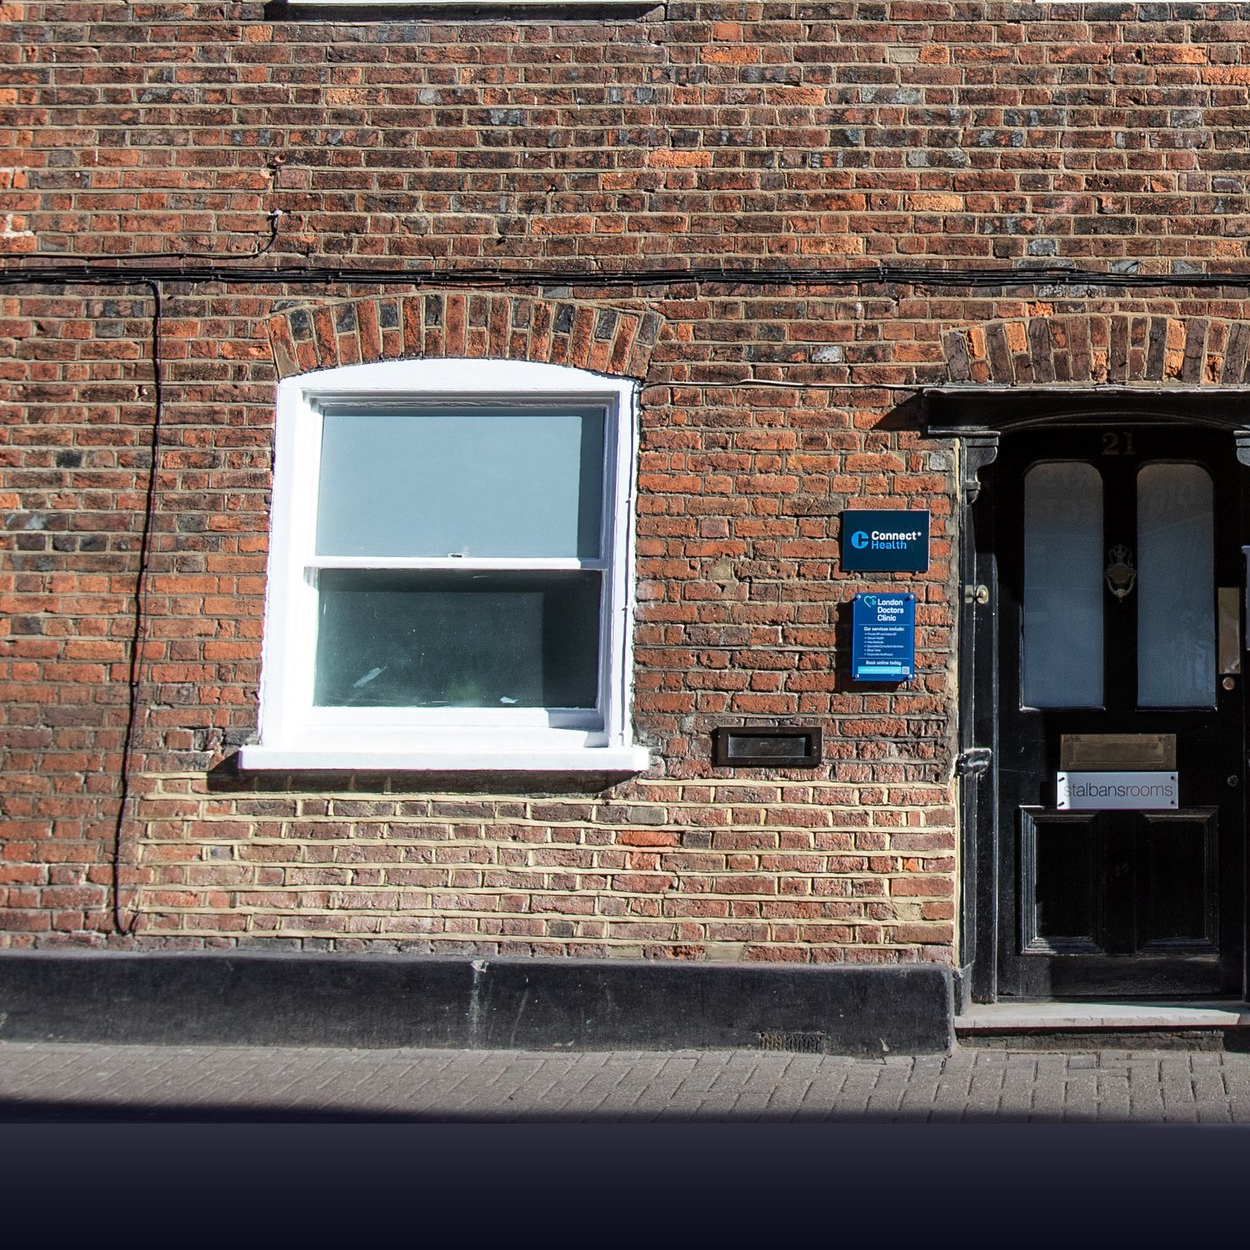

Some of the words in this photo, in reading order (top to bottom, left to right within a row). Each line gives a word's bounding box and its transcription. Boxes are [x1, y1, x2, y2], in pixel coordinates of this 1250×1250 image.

[1102, 431, 1135, 455] 21
[871, 530, 917, 541] Connect
[871, 540, 907, 550] Health
[877, 598, 904, 606] London
[877, 606, 904, 614] Doctors
[877, 614, 897, 622] Clinic
[1063, 782, 1174, 797] stalbansrooms
